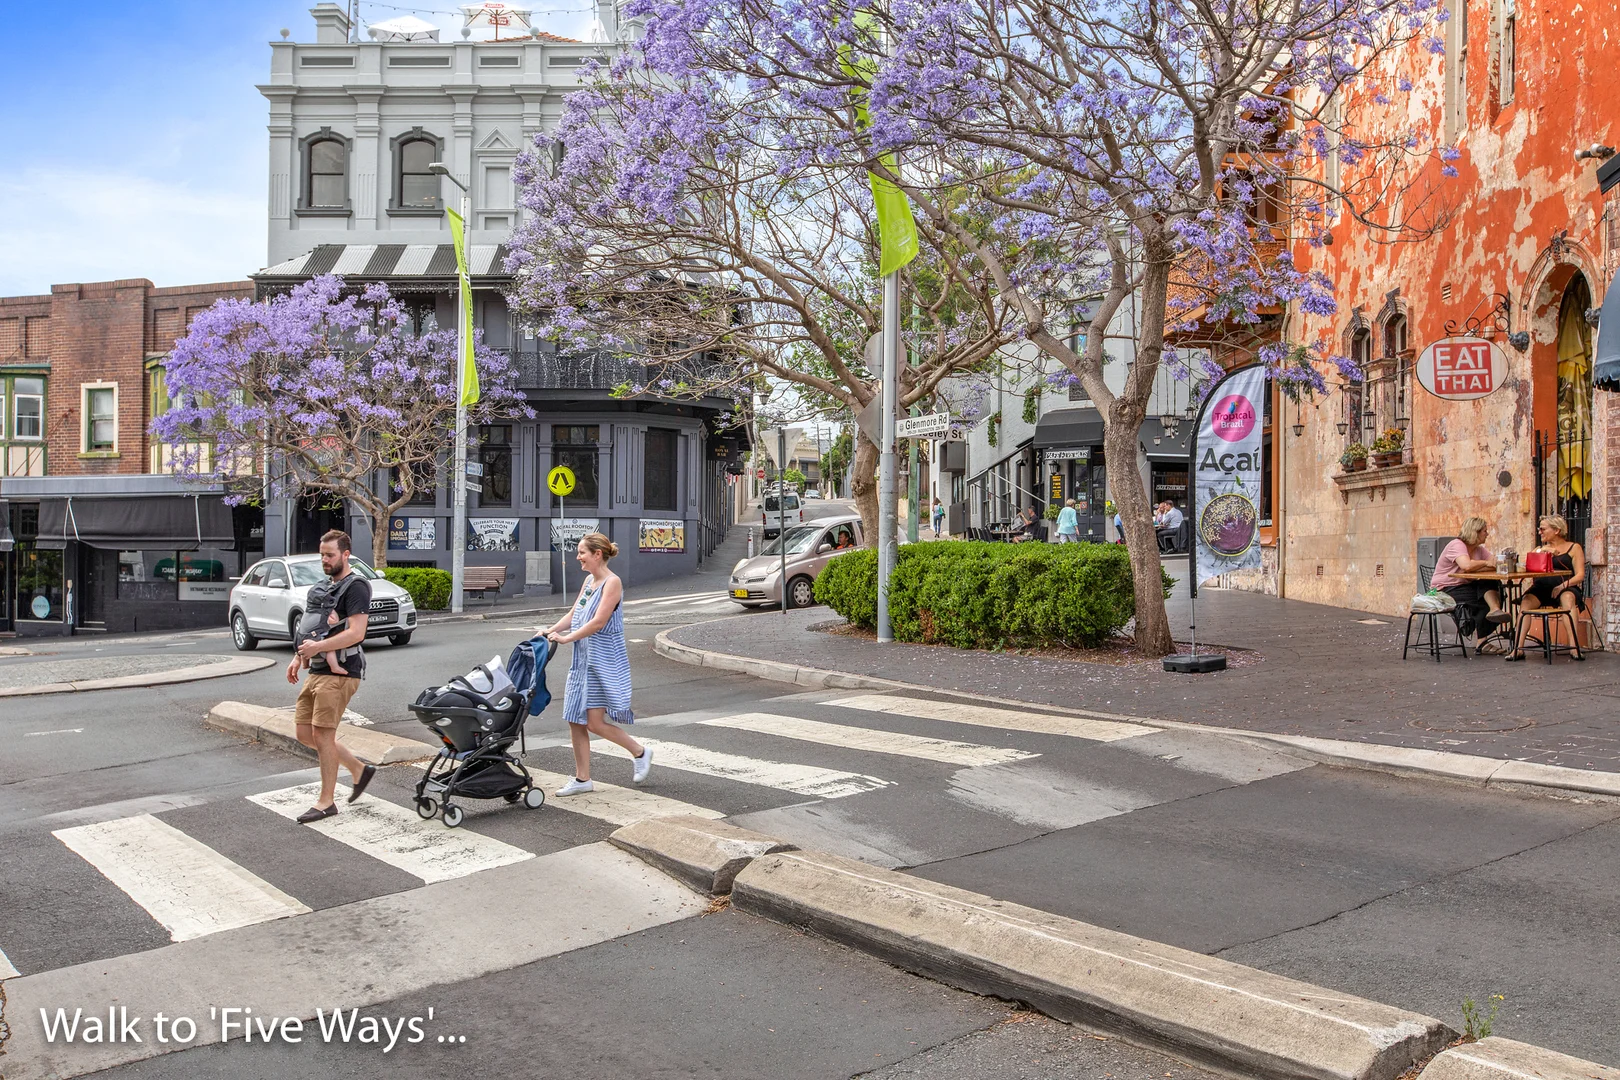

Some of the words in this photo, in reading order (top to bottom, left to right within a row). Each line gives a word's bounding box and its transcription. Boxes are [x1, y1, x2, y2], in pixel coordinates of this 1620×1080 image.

[1435, 346, 1488, 370] EAT
[1437, 374, 1490, 391] THAI
[905, 418, 937, 429] Glenmore
[938, 414, 947, 425] Rd
[1215, 411, 1252, 421] Tropical
[1220, 420, 1245, 428] Brazil
[919, 430, 948, 440] eeley
[951, 429, 962, 439] St
[1198, 447, 1261, 475] Açaí
